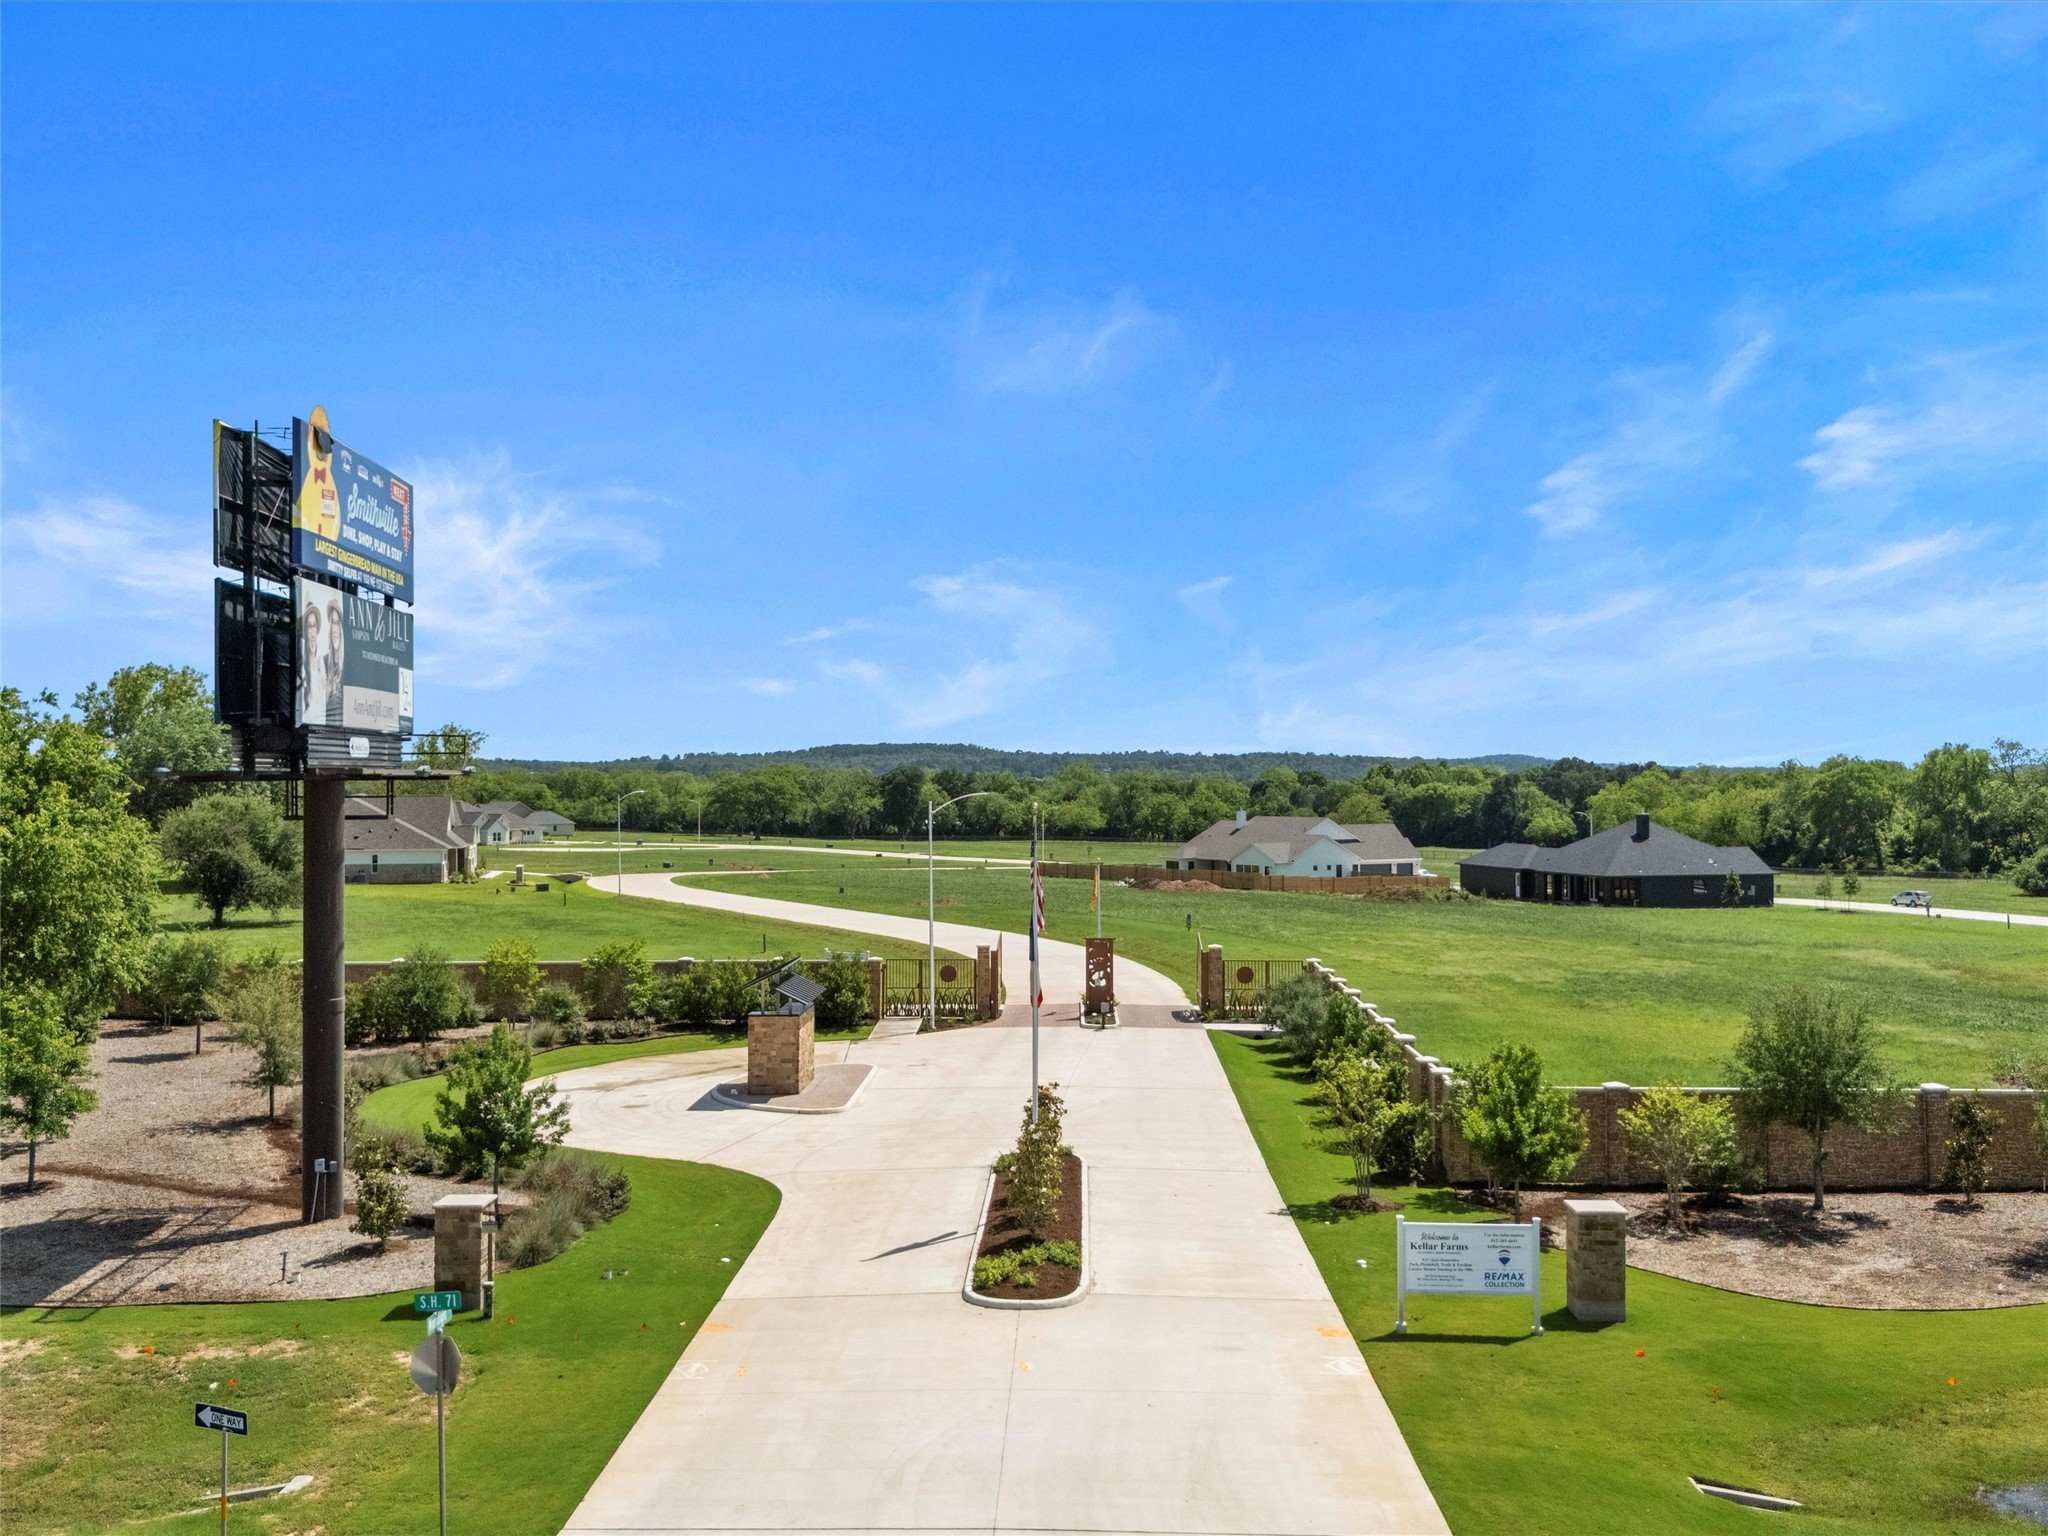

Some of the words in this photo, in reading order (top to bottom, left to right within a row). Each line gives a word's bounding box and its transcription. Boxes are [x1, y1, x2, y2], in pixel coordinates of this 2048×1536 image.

[347, 483, 400, 538] Smithville
[342, 523, 358, 545] DINE,
[358, 531, 373, 552] SHOP,
[373, 537, 387, 556] PLAY
[386, 544, 392, 558] &
[391, 546, 403, 563] STAY
[315, 537, 338, 559] LARGEST
[337, 547, 371, 572] GINGERBREAD
[370, 561, 382, 577] MAN
[381, 566, 388, 580] IN
[387, 569, 396, 583] THE
[395, 572, 404, 587] USA
[349, 597, 373, 631] ANN
[374, 604, 386, 643] &
[388, 609, 409, 642] JILL
[1421, 1232, 1451, 1241] Welcome
[1451, 1233, 1459, 1241] to
[1410, 1242, 1438, 1250] Kellar
[1440, 1242, 1469, 1251] Farms
[1484, 1272, 1524, 1281] RE/MAX
[420, 1295, 441, 1309] S.H.
[445, 1294, 456, 1307] 71
[211, 1412, 225, 1425] ONE
[226, 1417, 242, 1428] WAY
